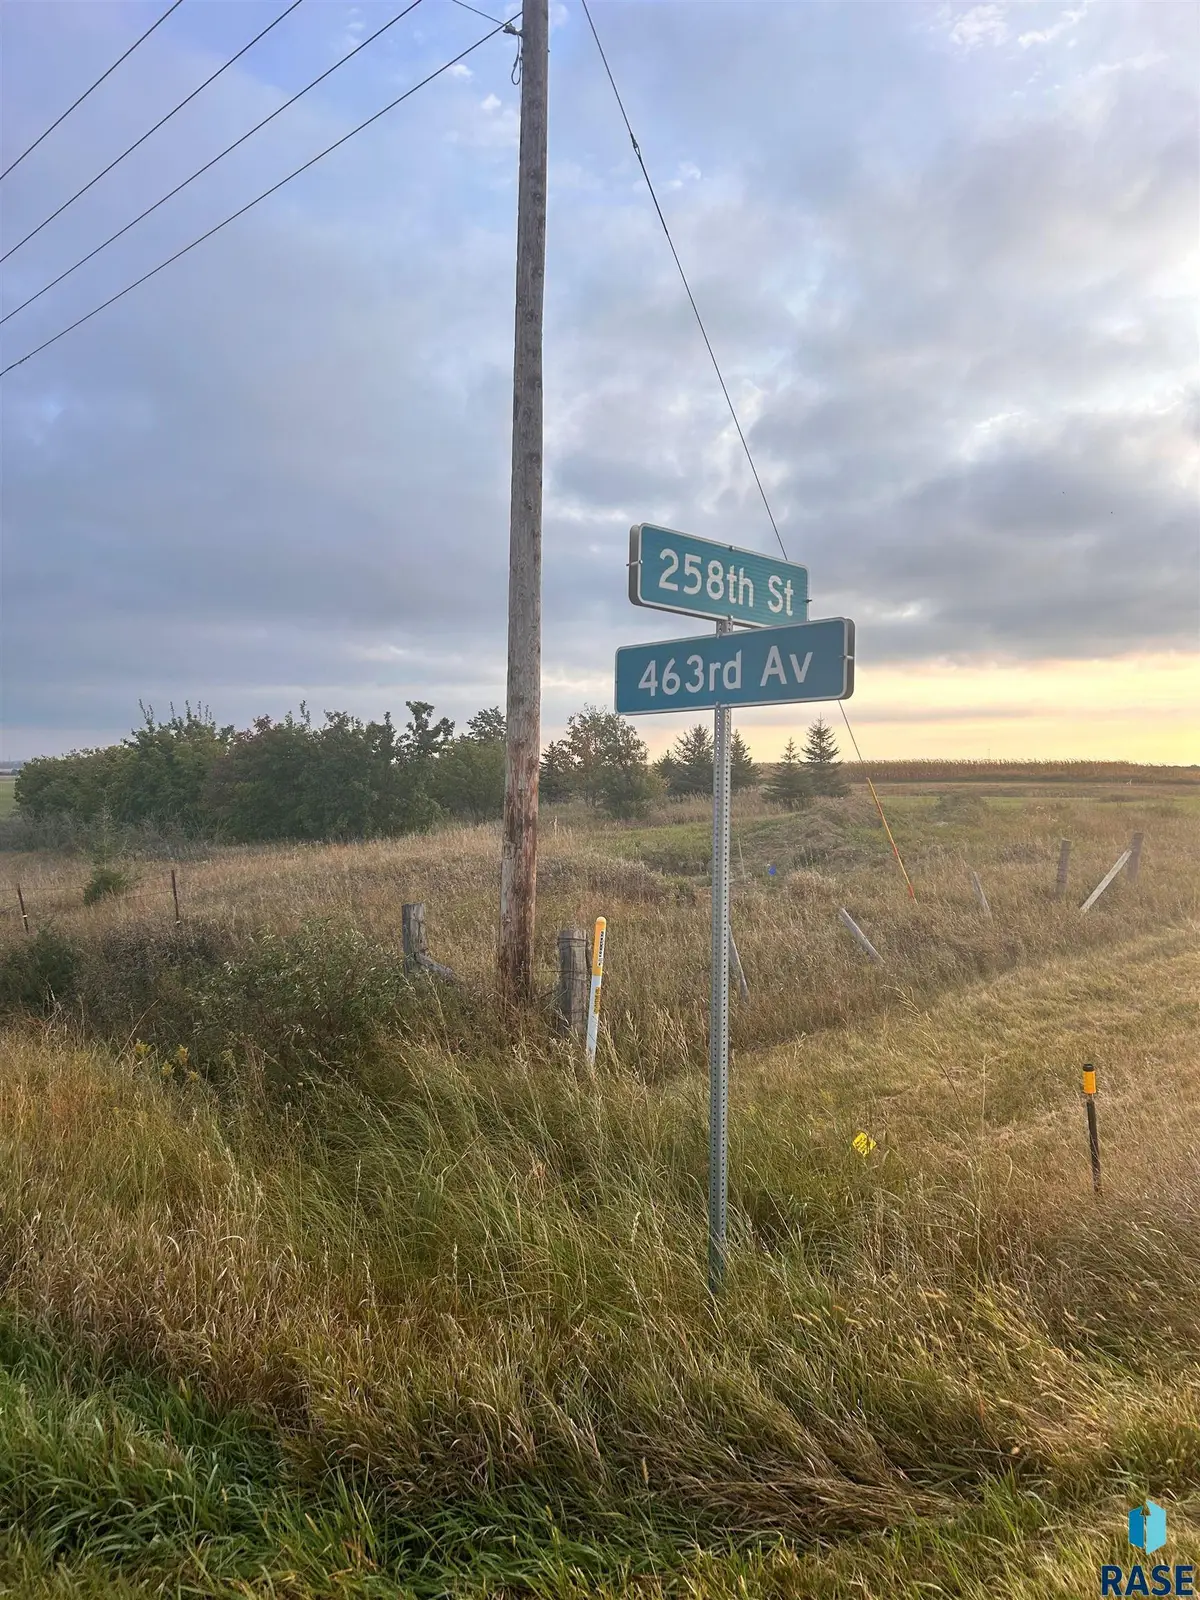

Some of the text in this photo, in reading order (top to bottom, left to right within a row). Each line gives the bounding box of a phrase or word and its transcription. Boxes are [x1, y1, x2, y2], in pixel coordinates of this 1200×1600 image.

[658, 548, 794, 616] 258th St
[638, 645, 813, 697] 463rd Av
